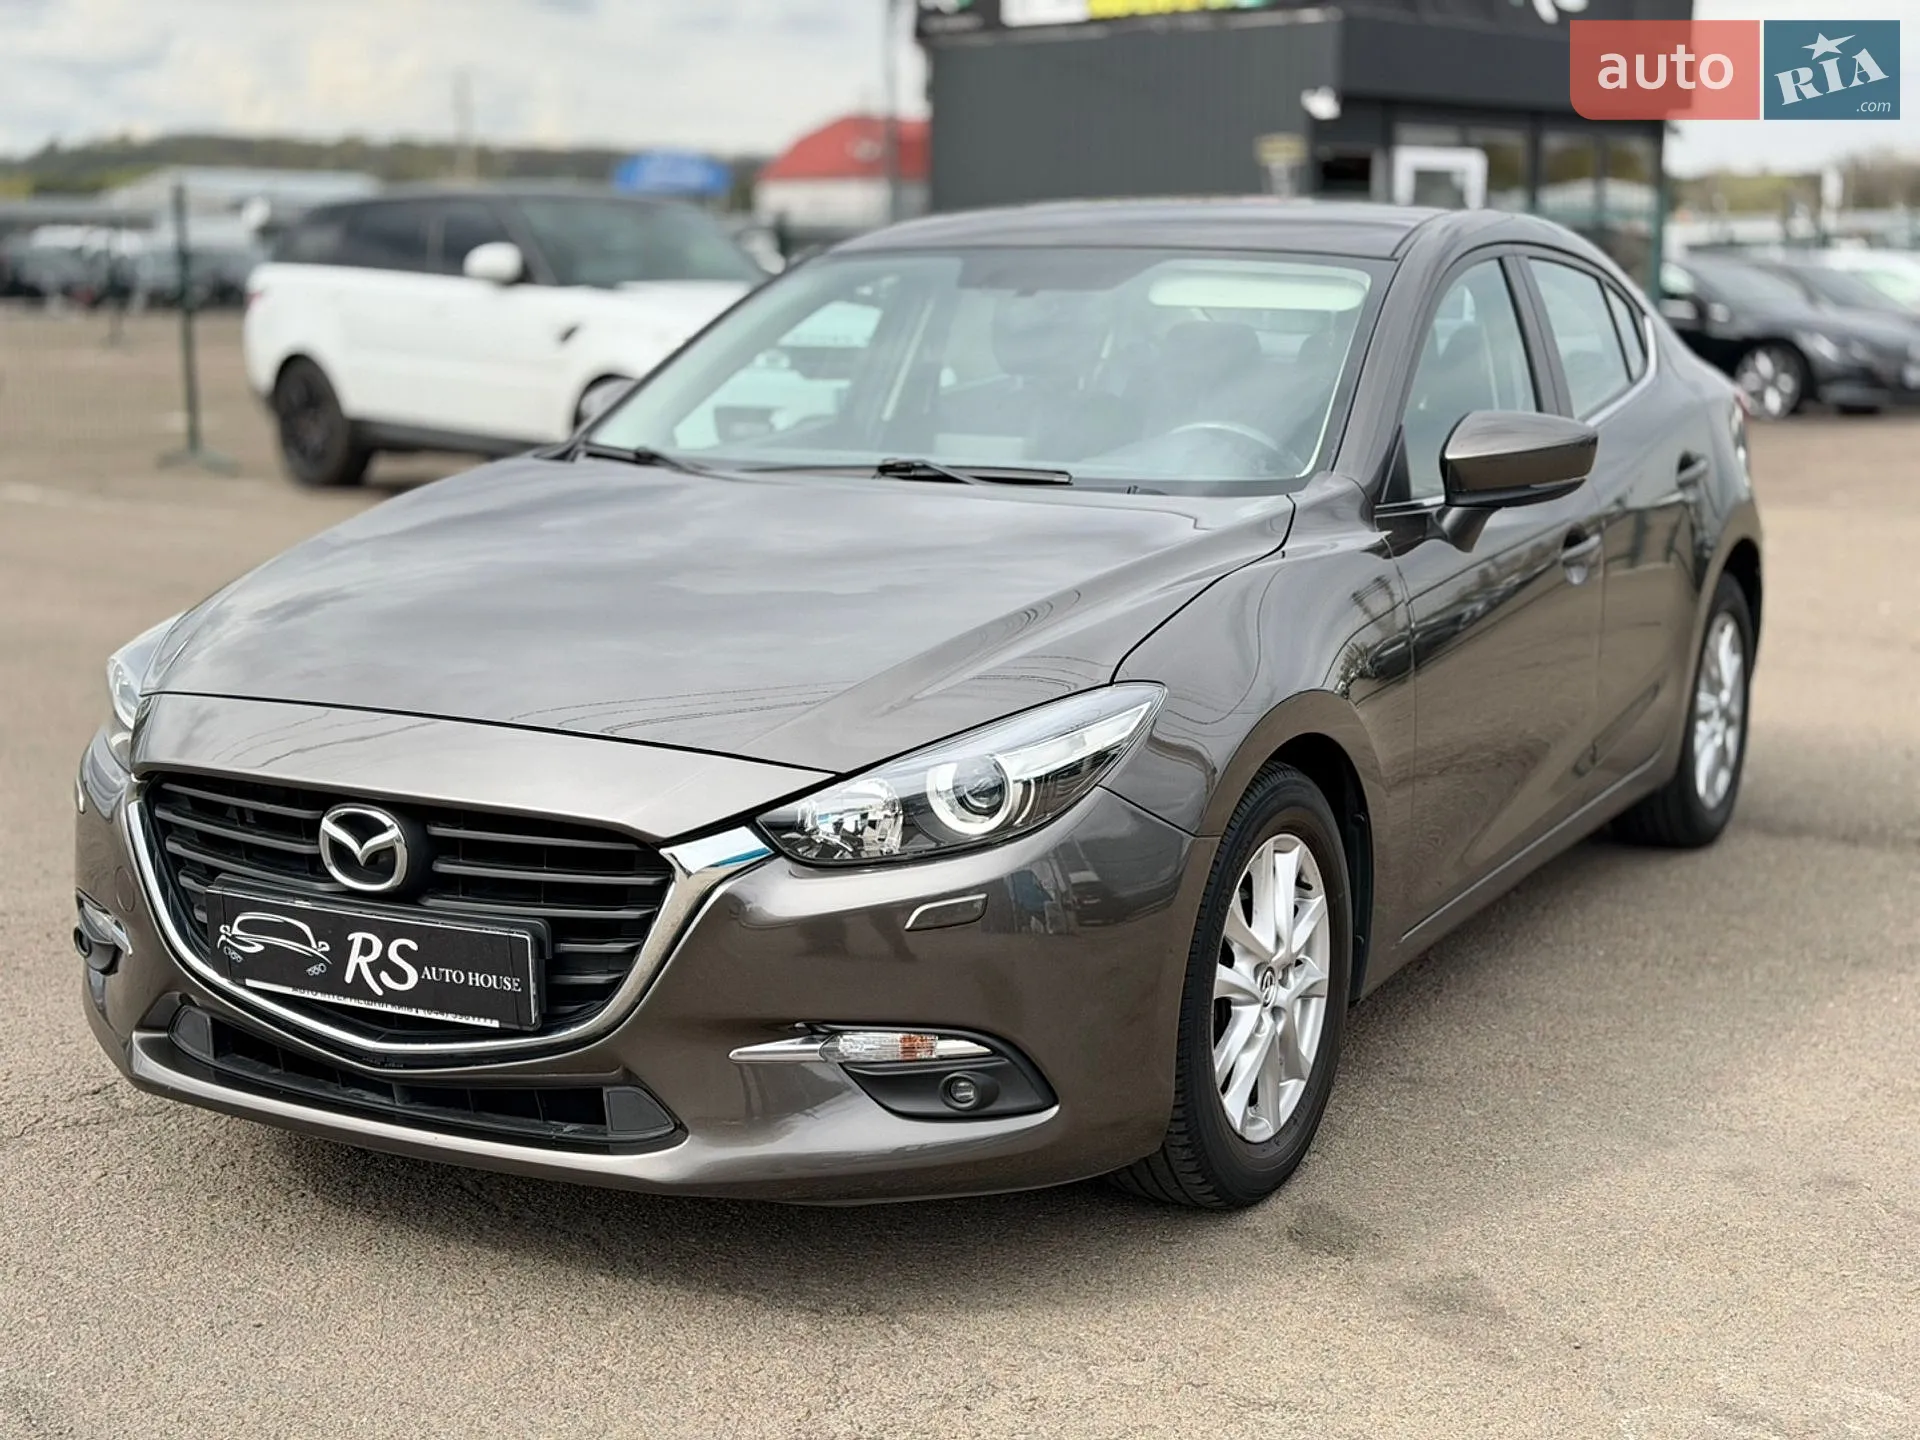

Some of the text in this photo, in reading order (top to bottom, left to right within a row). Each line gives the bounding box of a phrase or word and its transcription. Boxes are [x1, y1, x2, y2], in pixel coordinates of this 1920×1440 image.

[344, 931, 522, 996] RS AUTO HOUSE
